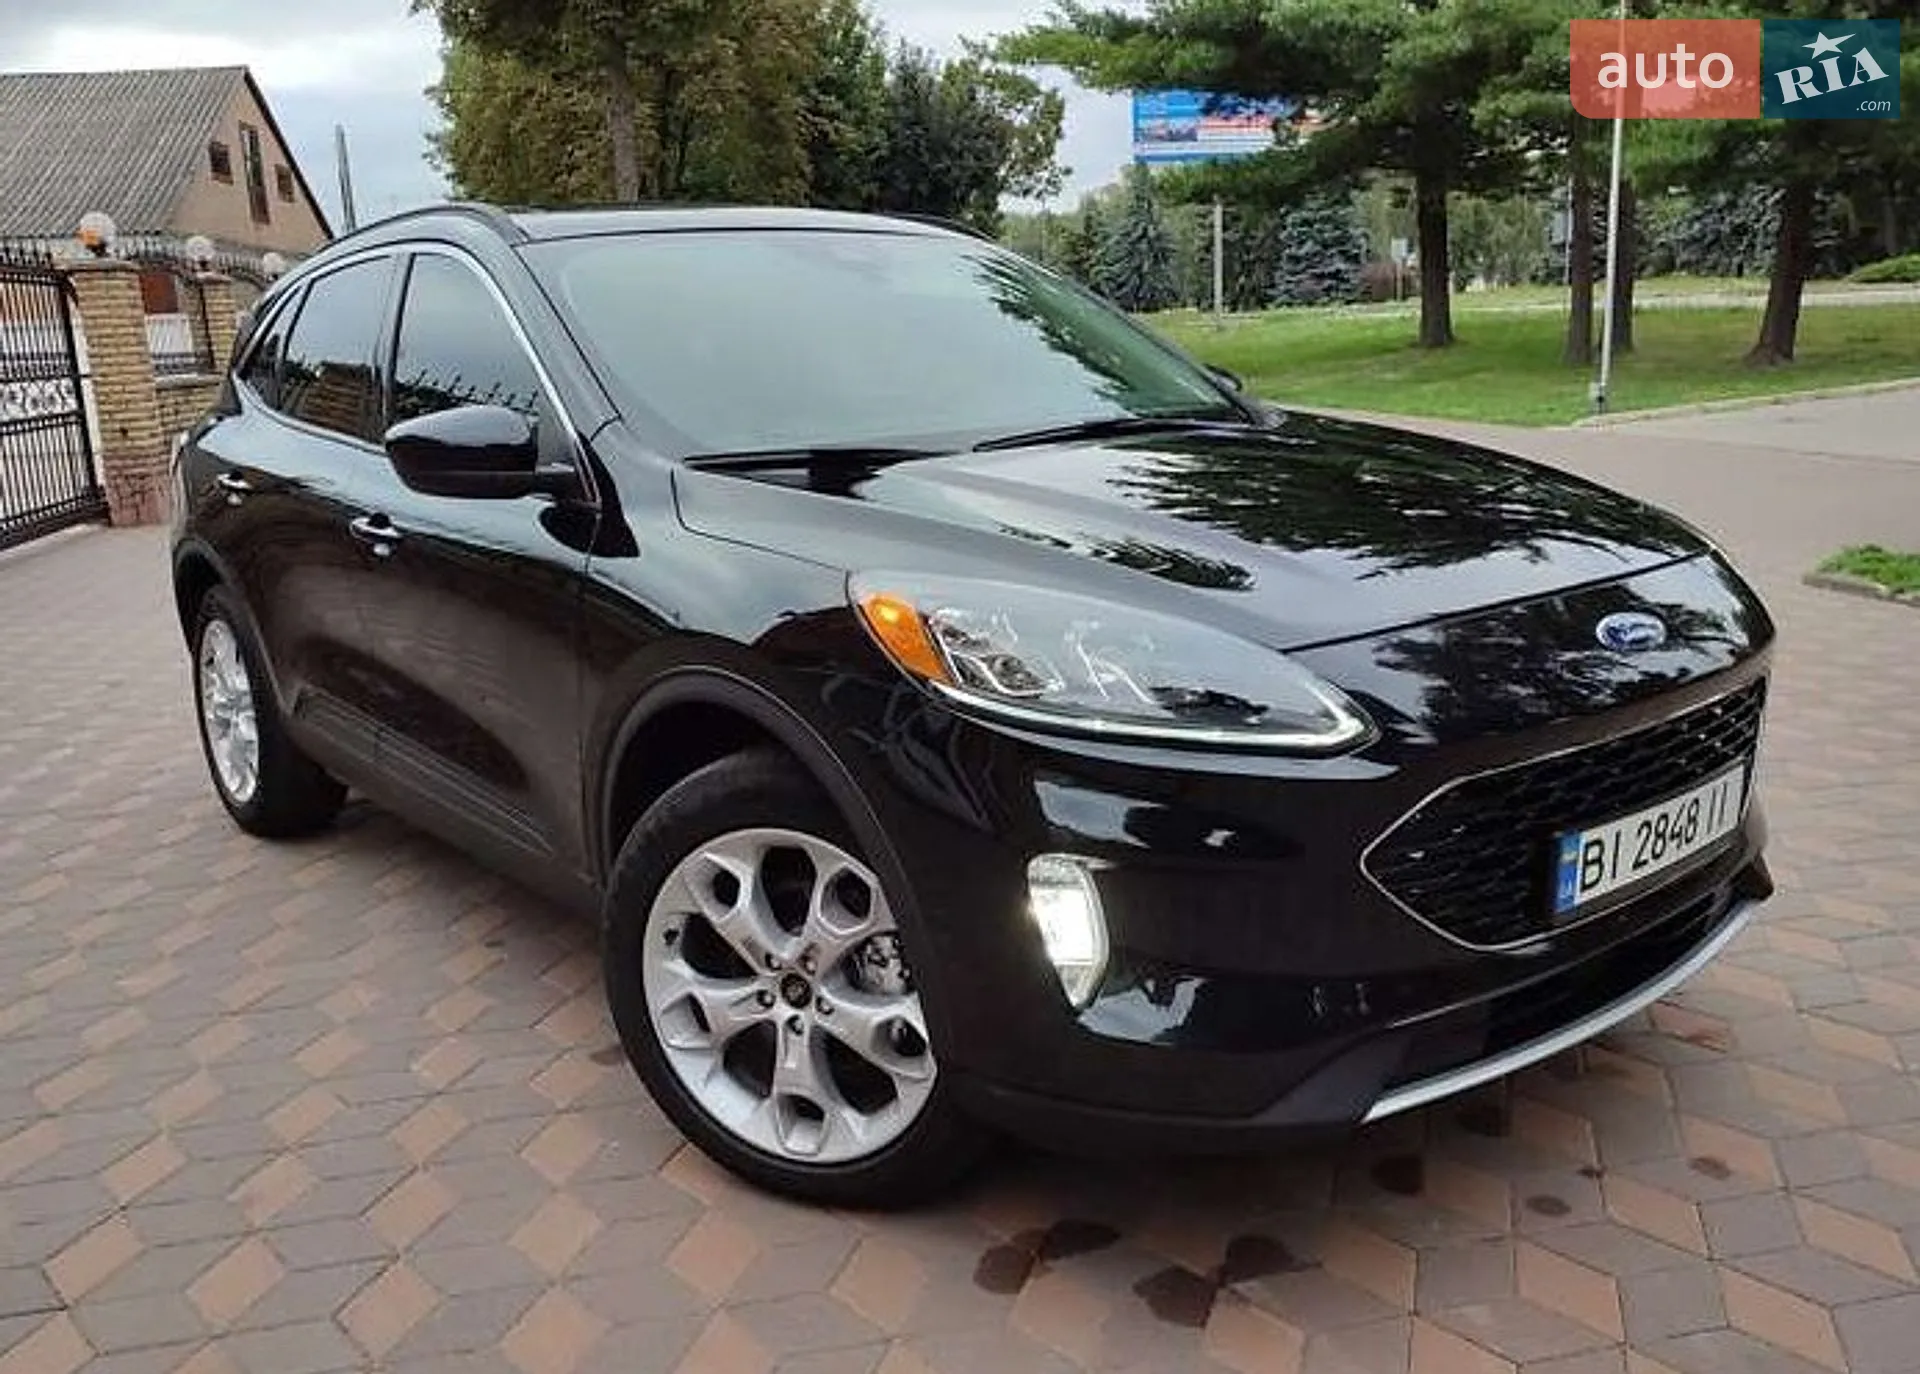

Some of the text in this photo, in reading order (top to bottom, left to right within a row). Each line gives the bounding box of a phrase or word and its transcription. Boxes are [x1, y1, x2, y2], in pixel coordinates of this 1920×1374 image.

[1580, 781, 1727, 892] BI 2848 II
